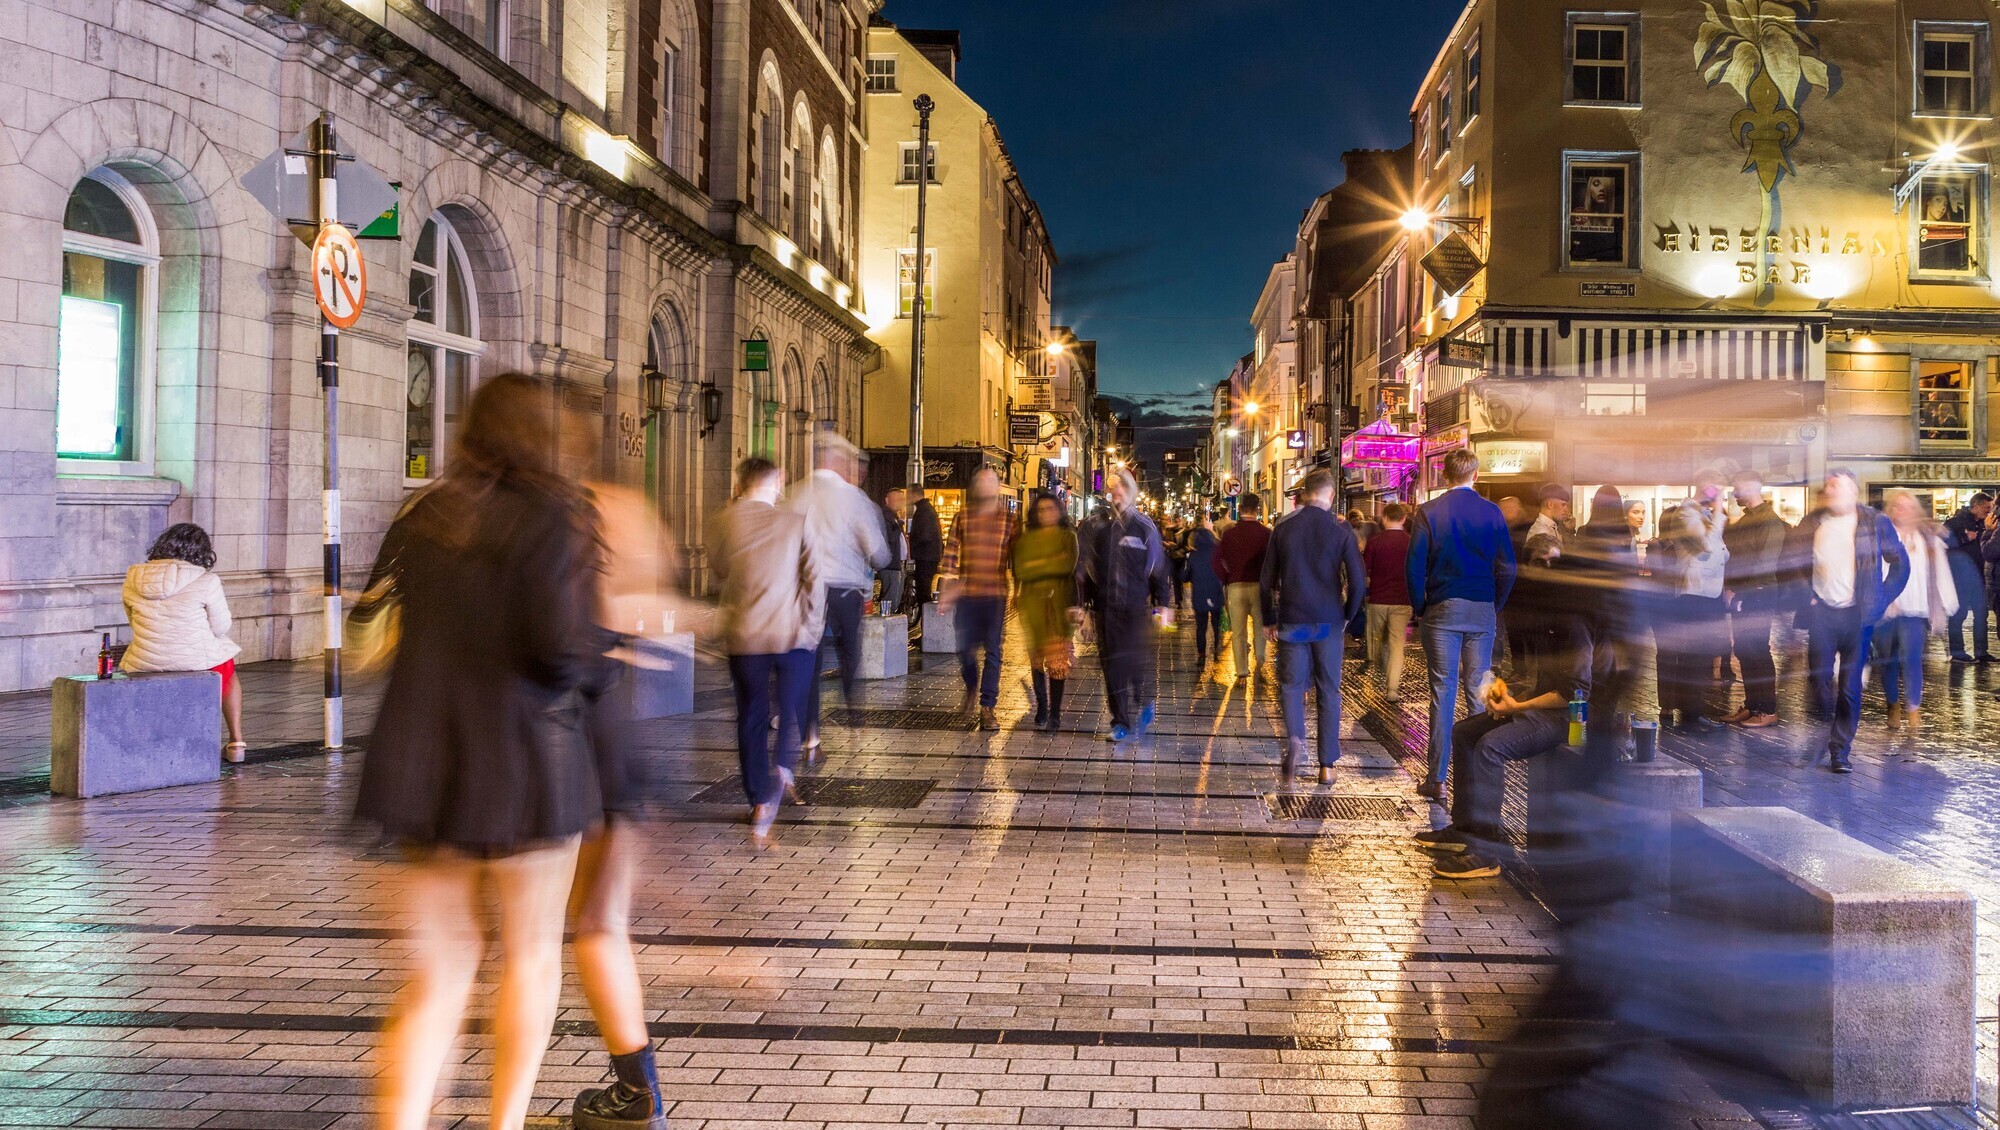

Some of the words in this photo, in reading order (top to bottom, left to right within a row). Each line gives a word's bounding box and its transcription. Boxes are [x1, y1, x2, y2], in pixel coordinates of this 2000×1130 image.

[1662, 232, 1888, 257] HIBERNIAN
[1430, 261, 1475, 269] HAIRDRESSING
[1738, 264, 1811, 285] BAR
[1381, 389, 1395, 397] The
[623, 411, 638, 433] an
[1801, 426, 1816, 438] life
[622, 434, 647, 457] post
[1500, 448, 1543, 456] pharmacy
